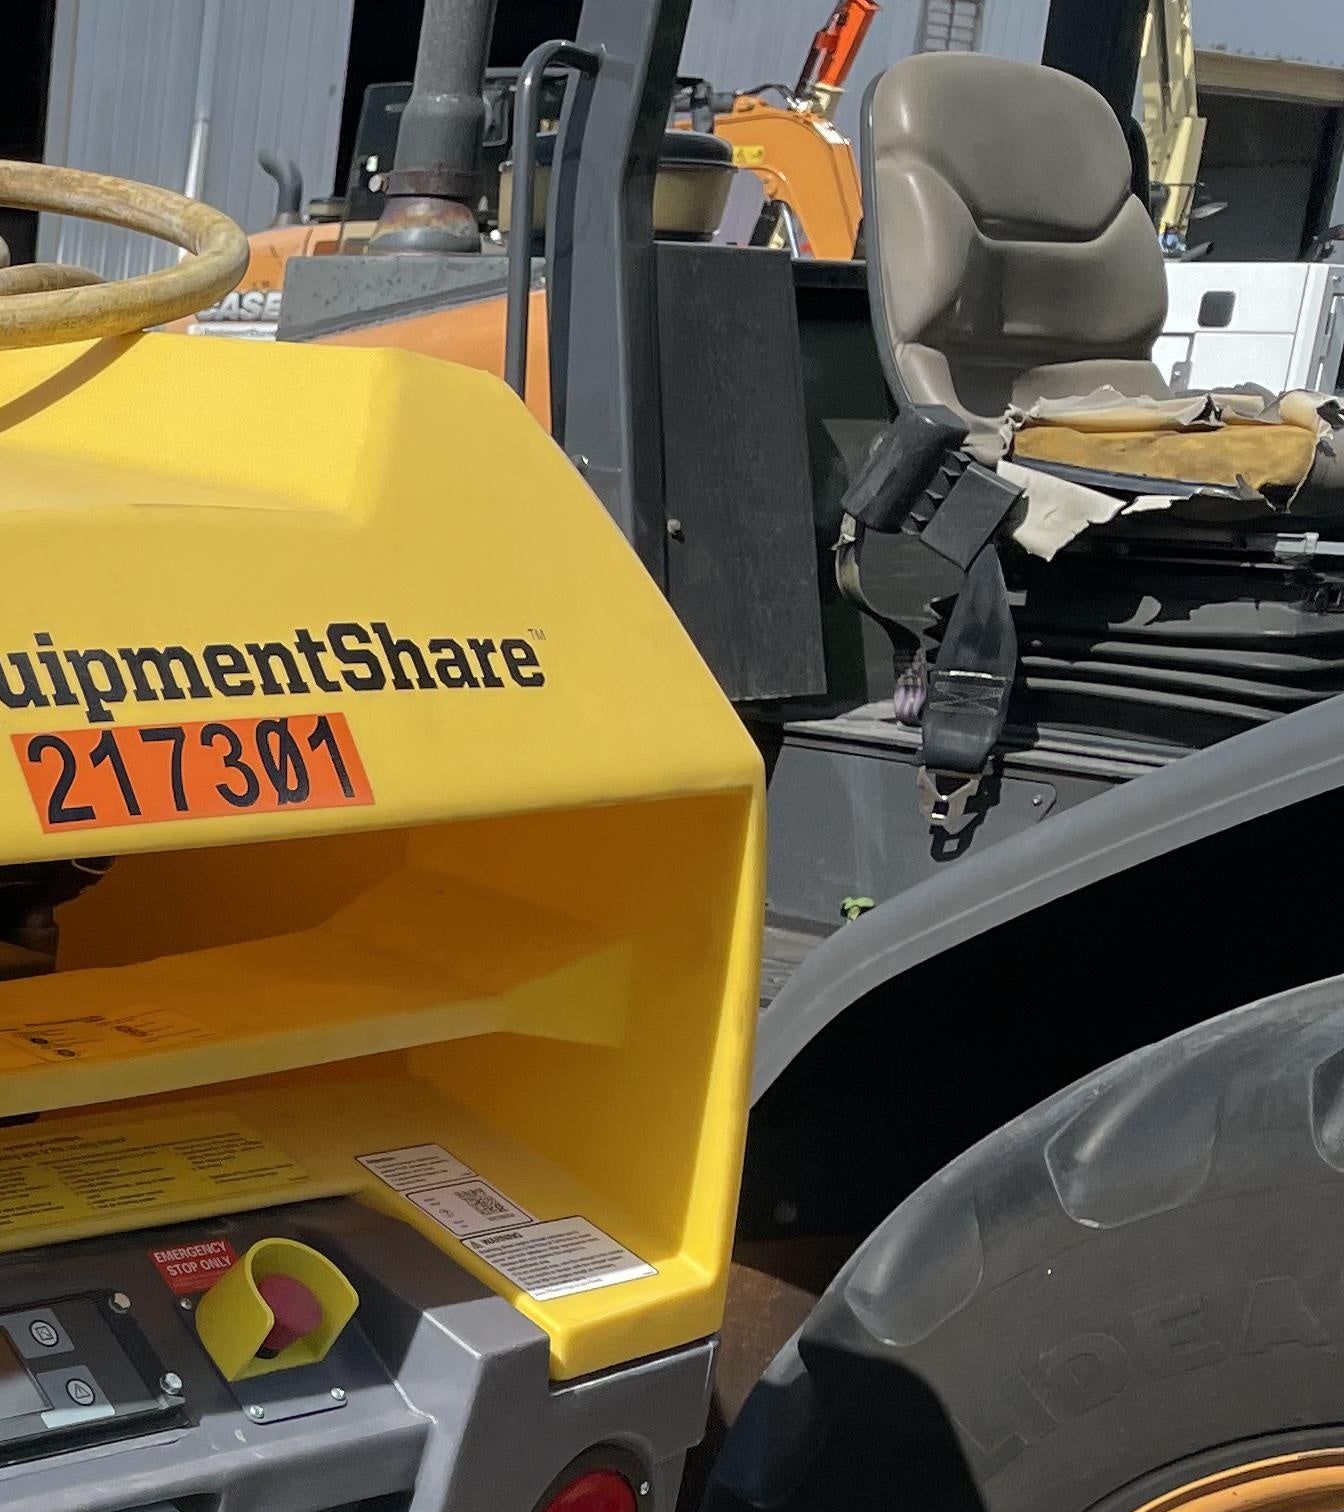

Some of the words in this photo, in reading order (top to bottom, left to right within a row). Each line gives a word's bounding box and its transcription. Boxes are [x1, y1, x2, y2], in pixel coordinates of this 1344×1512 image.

[195, 290, 282, 322] ASE
[26, 713, 356, 826] 217301
[154, 1240, 227, 1263] EMERGENCY
[166, 1261, 198, 1276] STOP
[199, 1255, 232, 1271] ONLY
